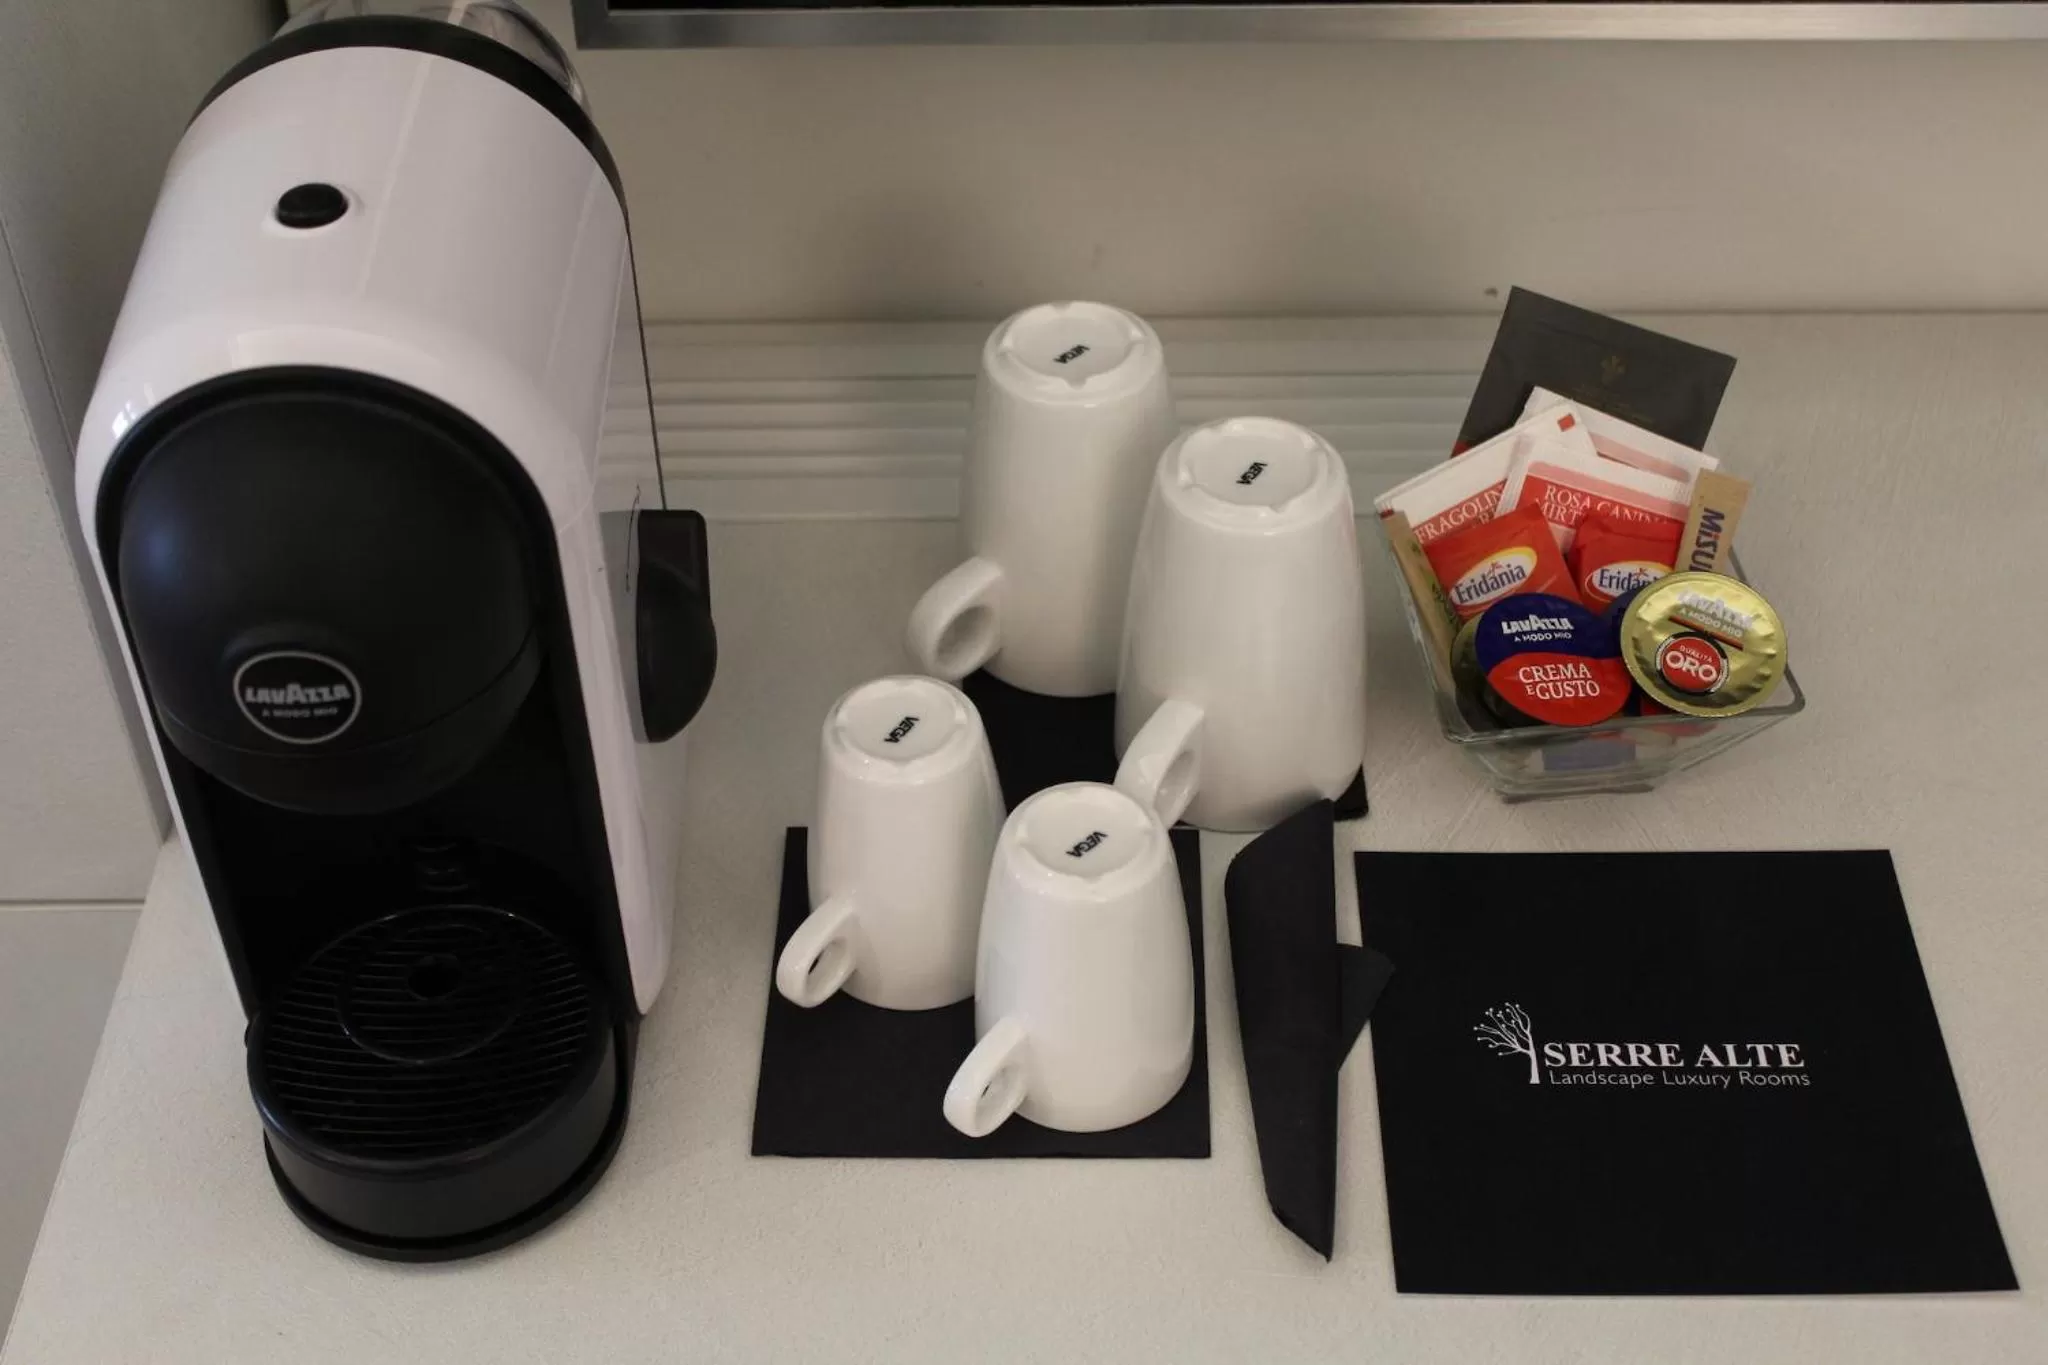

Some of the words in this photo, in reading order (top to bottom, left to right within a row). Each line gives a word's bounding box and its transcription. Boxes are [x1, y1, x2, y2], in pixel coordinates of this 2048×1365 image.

[1053, 344, 1091, 364] VEGA
[1236, 461, 1269, 485] VEGA
[1544, 484, 1591, 511] ROSA
[1502, 614, 1574, 634] LAVAZZA
[1522, 632, 1553, 642] MODO
[1554, 630, 1572, 640] MIO
[1519, 663, 1592, 683] CREMA
[1665, 650, 1718, 681] ORO
[245, 682, 351, 705] LAVAZZA
[1525, 684, 1536, 696] E
[1535, 680, 1600, 700] GUSTO
[884, 716, 920, 744] VEGA
[1066, 831, 1108, 858] VEGA
[1543, 1042, 1685, 1068] SERRE
[1694, 1042, 1805, 1068] ALTE
[1549, 1070, 1655, 1089] Landscape
[1661, 1070, 1731, 1089] Luxury
[1738, 1070, 1811, 1087] Rooms
